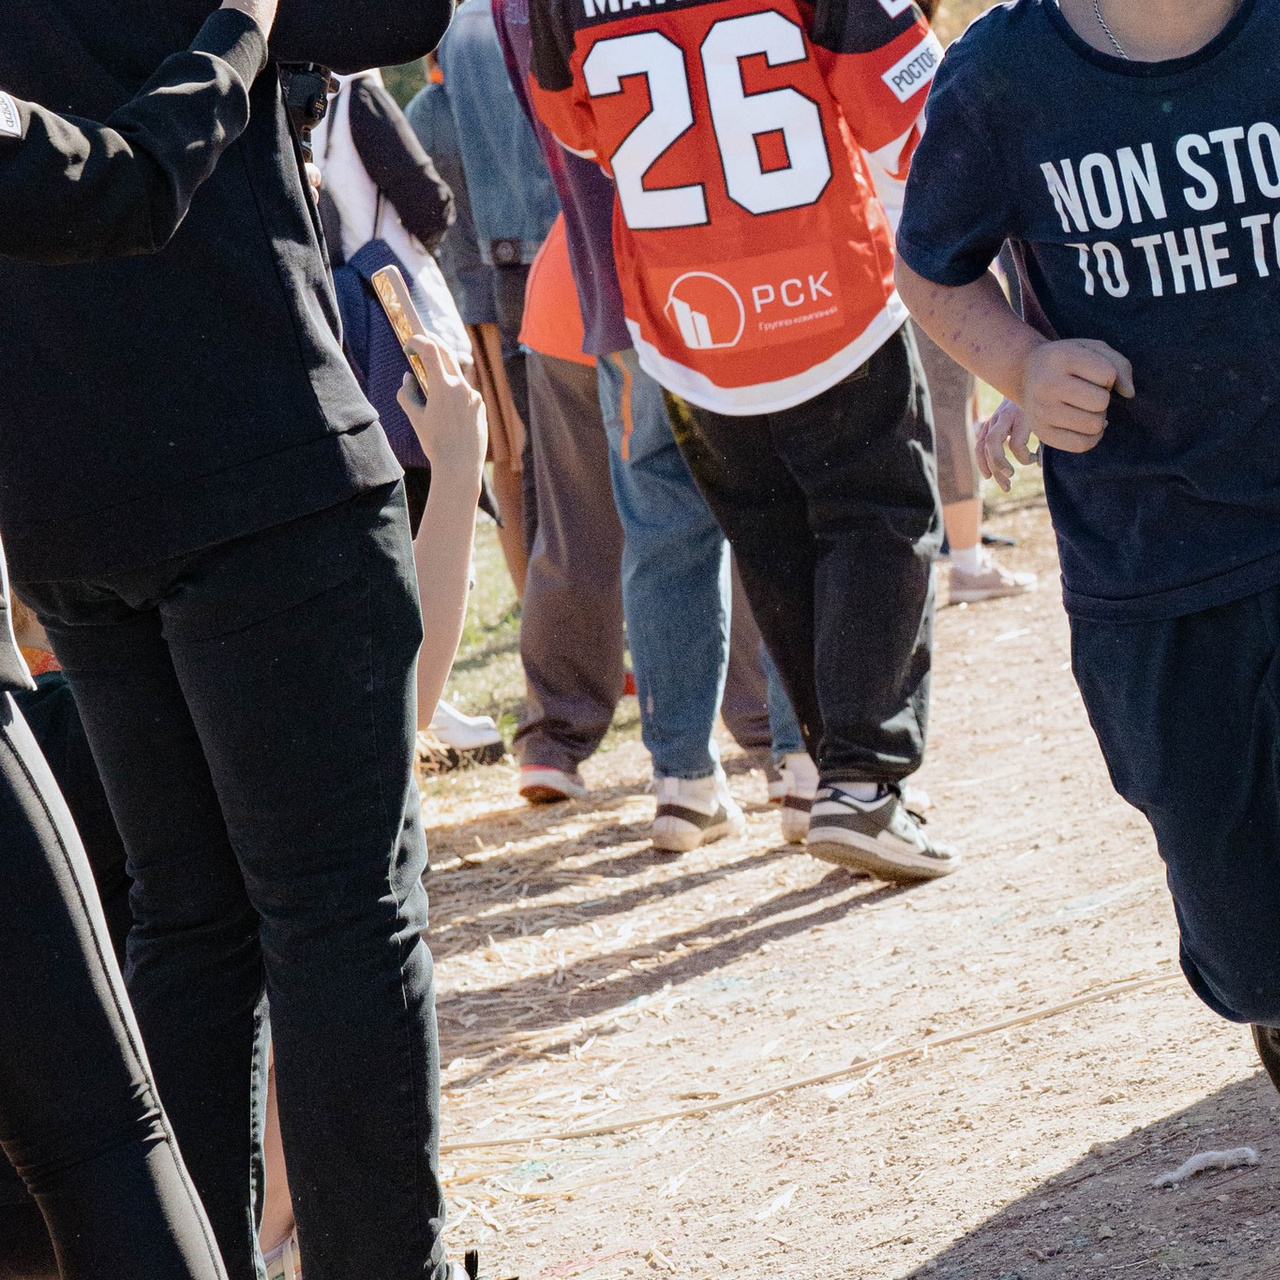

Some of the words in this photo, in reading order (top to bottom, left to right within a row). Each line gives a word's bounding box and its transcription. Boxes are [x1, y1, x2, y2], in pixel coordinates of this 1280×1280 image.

[582, 8, 834, 231] 26
[1040, 142, 1168, 233] NON
[752, 271, 833, 314] РСК
[1064, 241, 1130, 298] TO
[1131, 222, 1238, 297] THE
